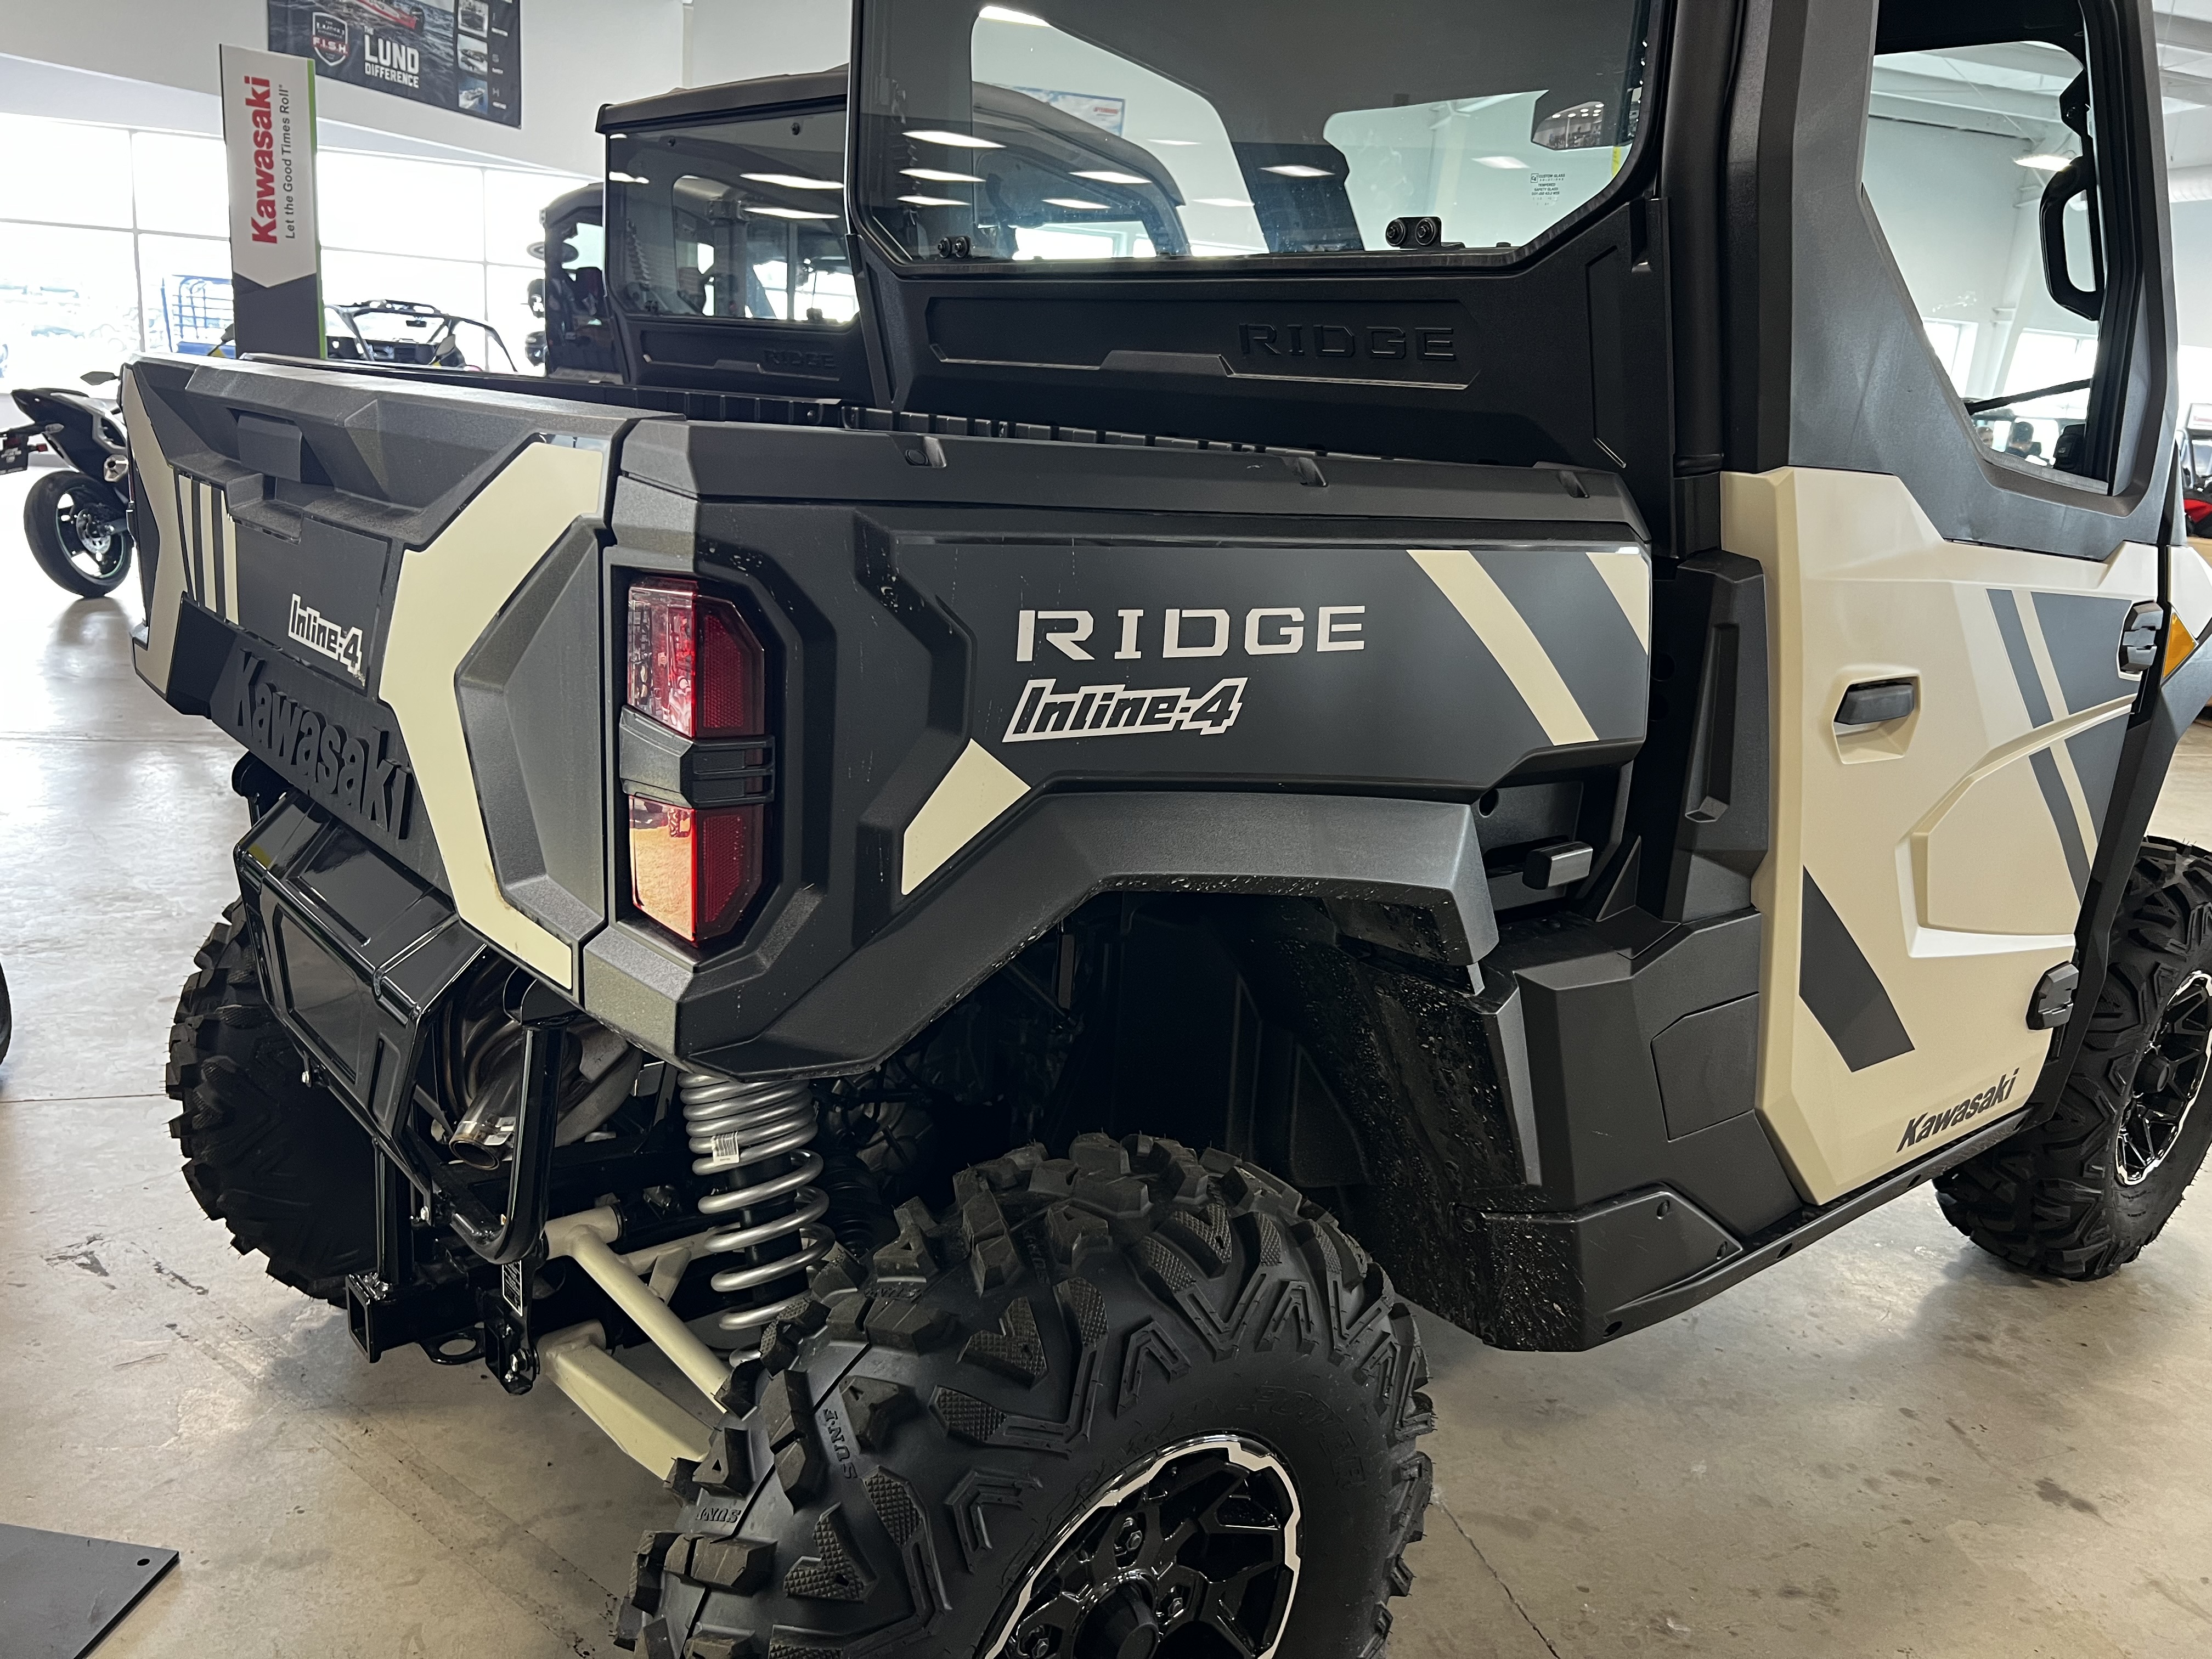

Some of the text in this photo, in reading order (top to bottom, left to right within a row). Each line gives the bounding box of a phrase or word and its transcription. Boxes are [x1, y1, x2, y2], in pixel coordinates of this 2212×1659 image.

[364, 34, 419, 75] LUND
[364, 62, 419, 88] DIFFERENCE
[281, 117, 291, 155] Times
[244, 75, 278, 244] Kawasaki
[283, 159, 293, 193] Good
[284, 196, 294, 218] the
[285, 220, 295, 239] Let
[763, 348, 837, 369] RIDGE
[1239, 323, 1457, 362] RIDGE
[288, 593, 363, 675] Inline-4
[1017, 605, 1365, 662] RIDGE
[1003, 678, 1248, 742] Inline-4
[237, 648, 412, 840] Kawasaki
[1896, 1067, 2020, 1153] Kawasaki
